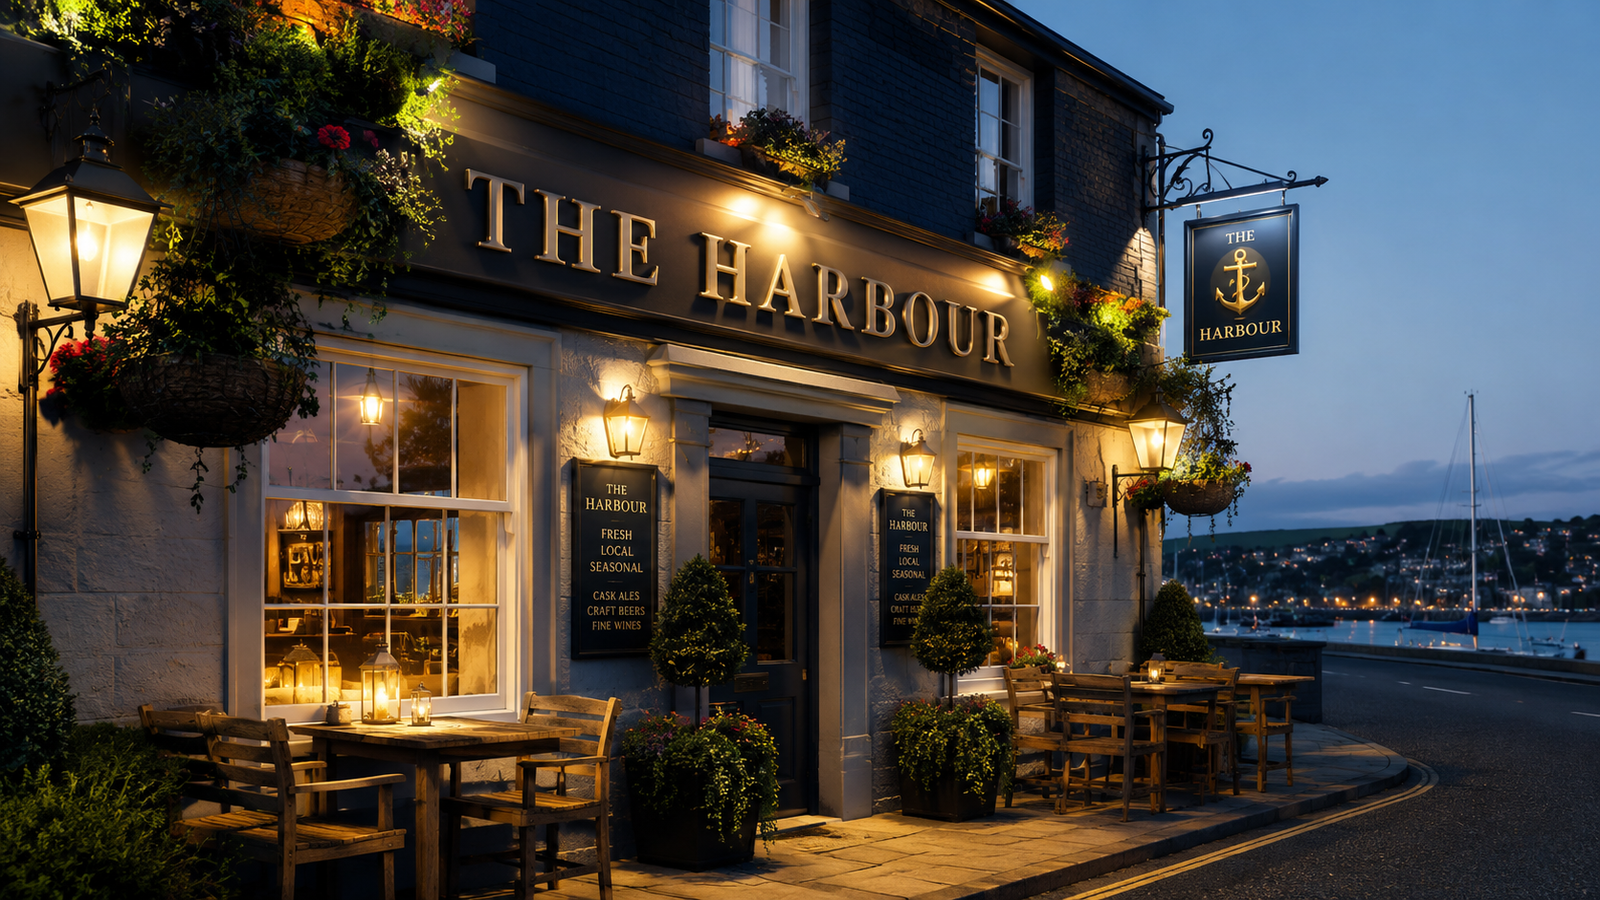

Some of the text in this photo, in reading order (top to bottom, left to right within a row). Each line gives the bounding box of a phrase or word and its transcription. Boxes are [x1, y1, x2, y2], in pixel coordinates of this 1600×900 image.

[1225, 229, 1255, 244] THE
[464, 168, 1015, 367] THE HARBOUR
[1199, 319, 1283, 342] HARBOUR
[605, 483, 628, 495] THE
[585, 497, 647, 514] HARBOUR
[901, 508, 916, 518] THE
[889, 519, 928, 532] HARBOUR
[601, 528, 632, 540] FRESH
[600, 545, 634, 557] LOCAL
[899, 543, 920, 553] FRESH
[589, 560, 643, 573] SEASONAL
[899, 556, 920, 566] LOCAL
[891, 569, 926, 579] SEASONAL
[592, 591, 640, 601] CASK ALES
[894, 593, 910, 602] CASK
[587, 605, 646, 616] CRAFT BEERS
[592, 620, 642, 631] FINE WINES
